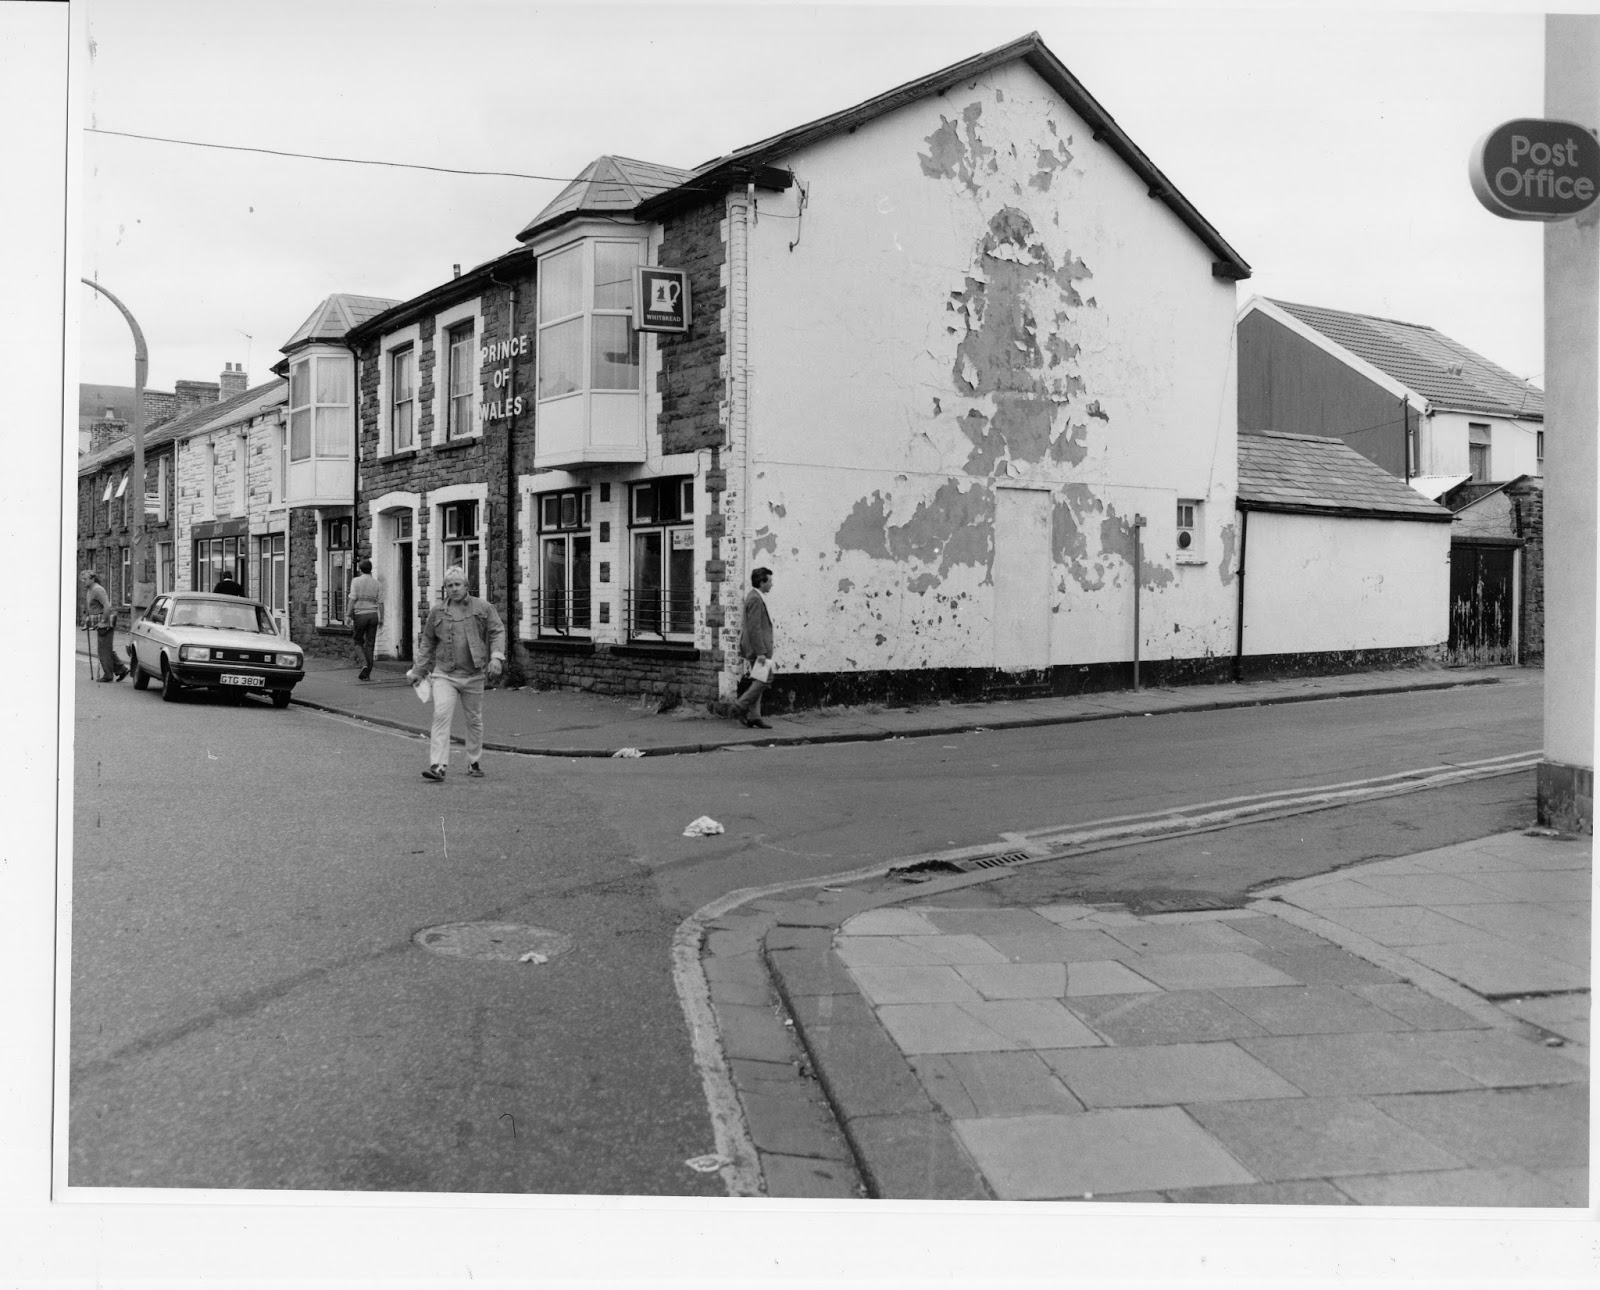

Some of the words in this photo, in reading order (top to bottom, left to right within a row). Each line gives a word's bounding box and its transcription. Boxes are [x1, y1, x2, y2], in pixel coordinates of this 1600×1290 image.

[1511, 134, 1579, 167] Post
[1494, 166, 1595, 200] Office
[646, 314, 682, 322] WHITBREAD
[481, 335, 528, 362] PRINCE
[493, 367, 509, 388] OF
[478, 396, 522, 421] WALES
[221, 675, 240, 685] GTG
[241, 676, 265, 686] 380W
